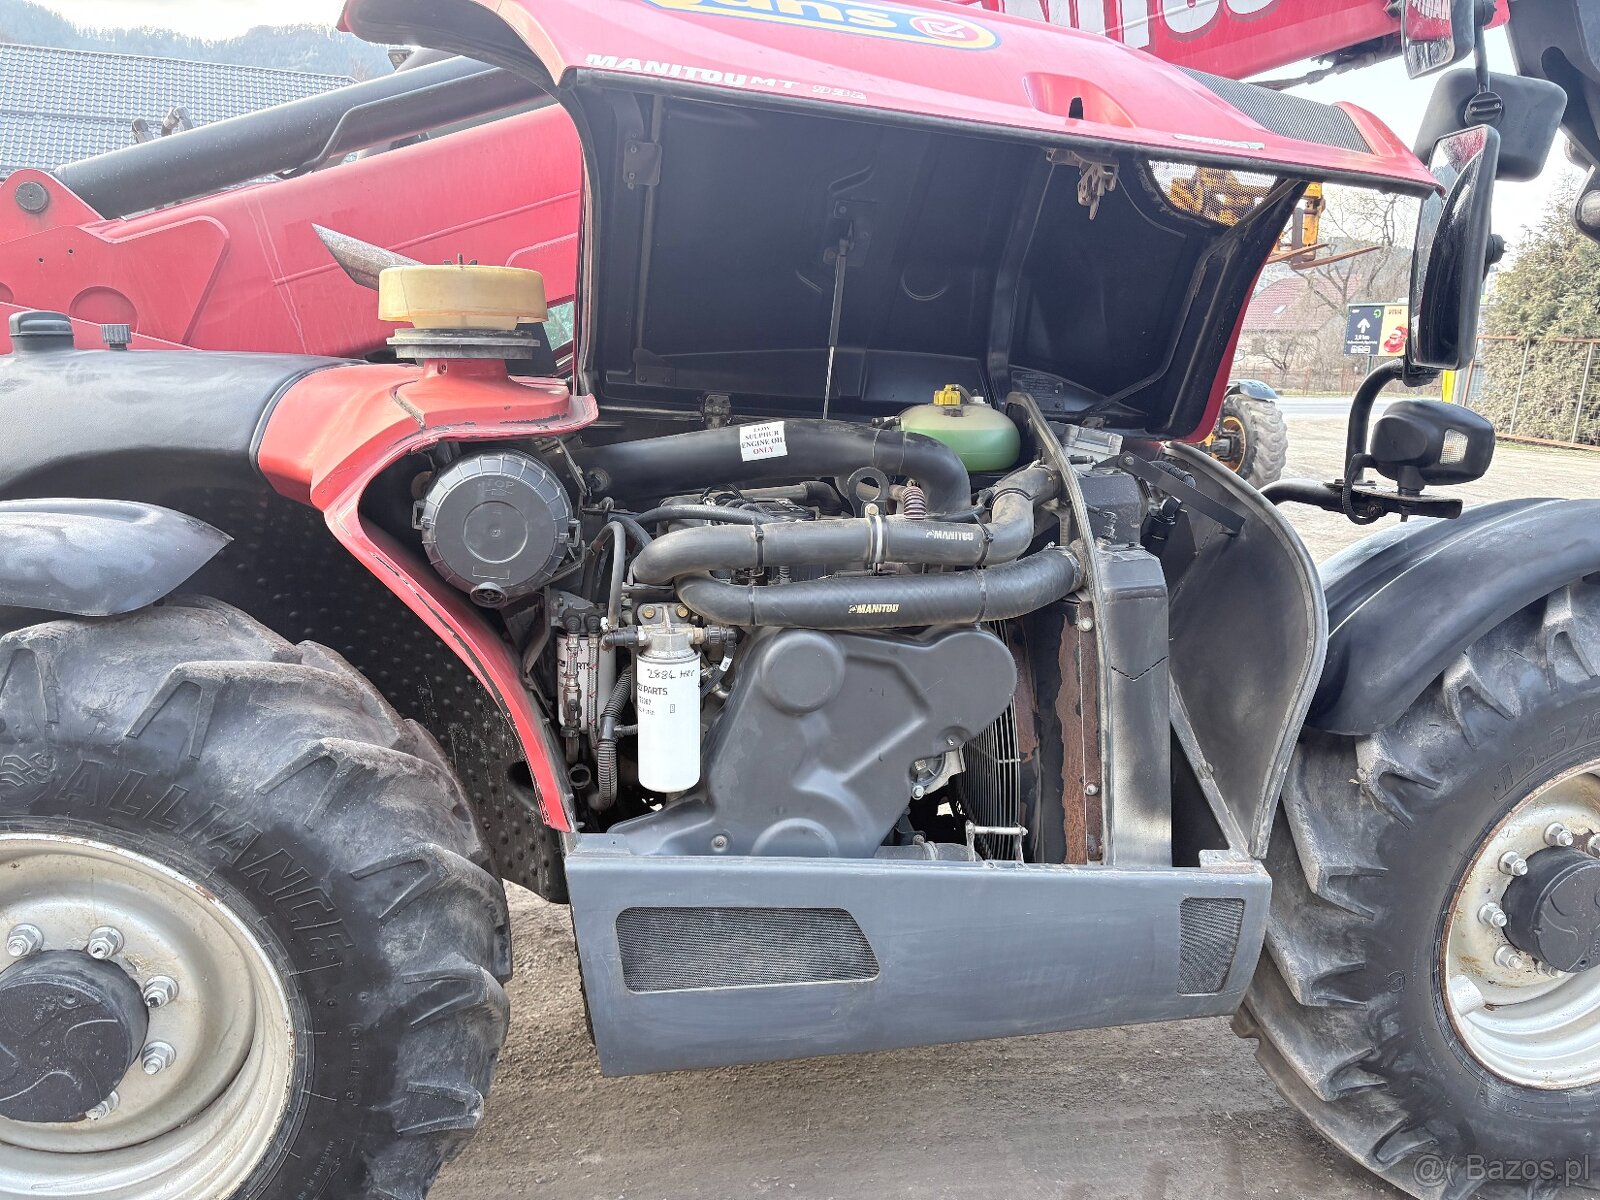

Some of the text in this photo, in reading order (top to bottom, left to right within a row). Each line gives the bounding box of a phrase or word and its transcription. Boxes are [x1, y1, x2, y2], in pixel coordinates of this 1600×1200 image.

[586, 53, 747, 87] MANITOU
[750, 77, 801, 90] MT
[741, 438, 770, 449] ENGINE
[752, 446, 774, 455] ONLY
[856, 603, 900, 614] MANITOU
[643, 685, 668, 696] PARTS
[54, 759, 355, 958] ALLIANCE
